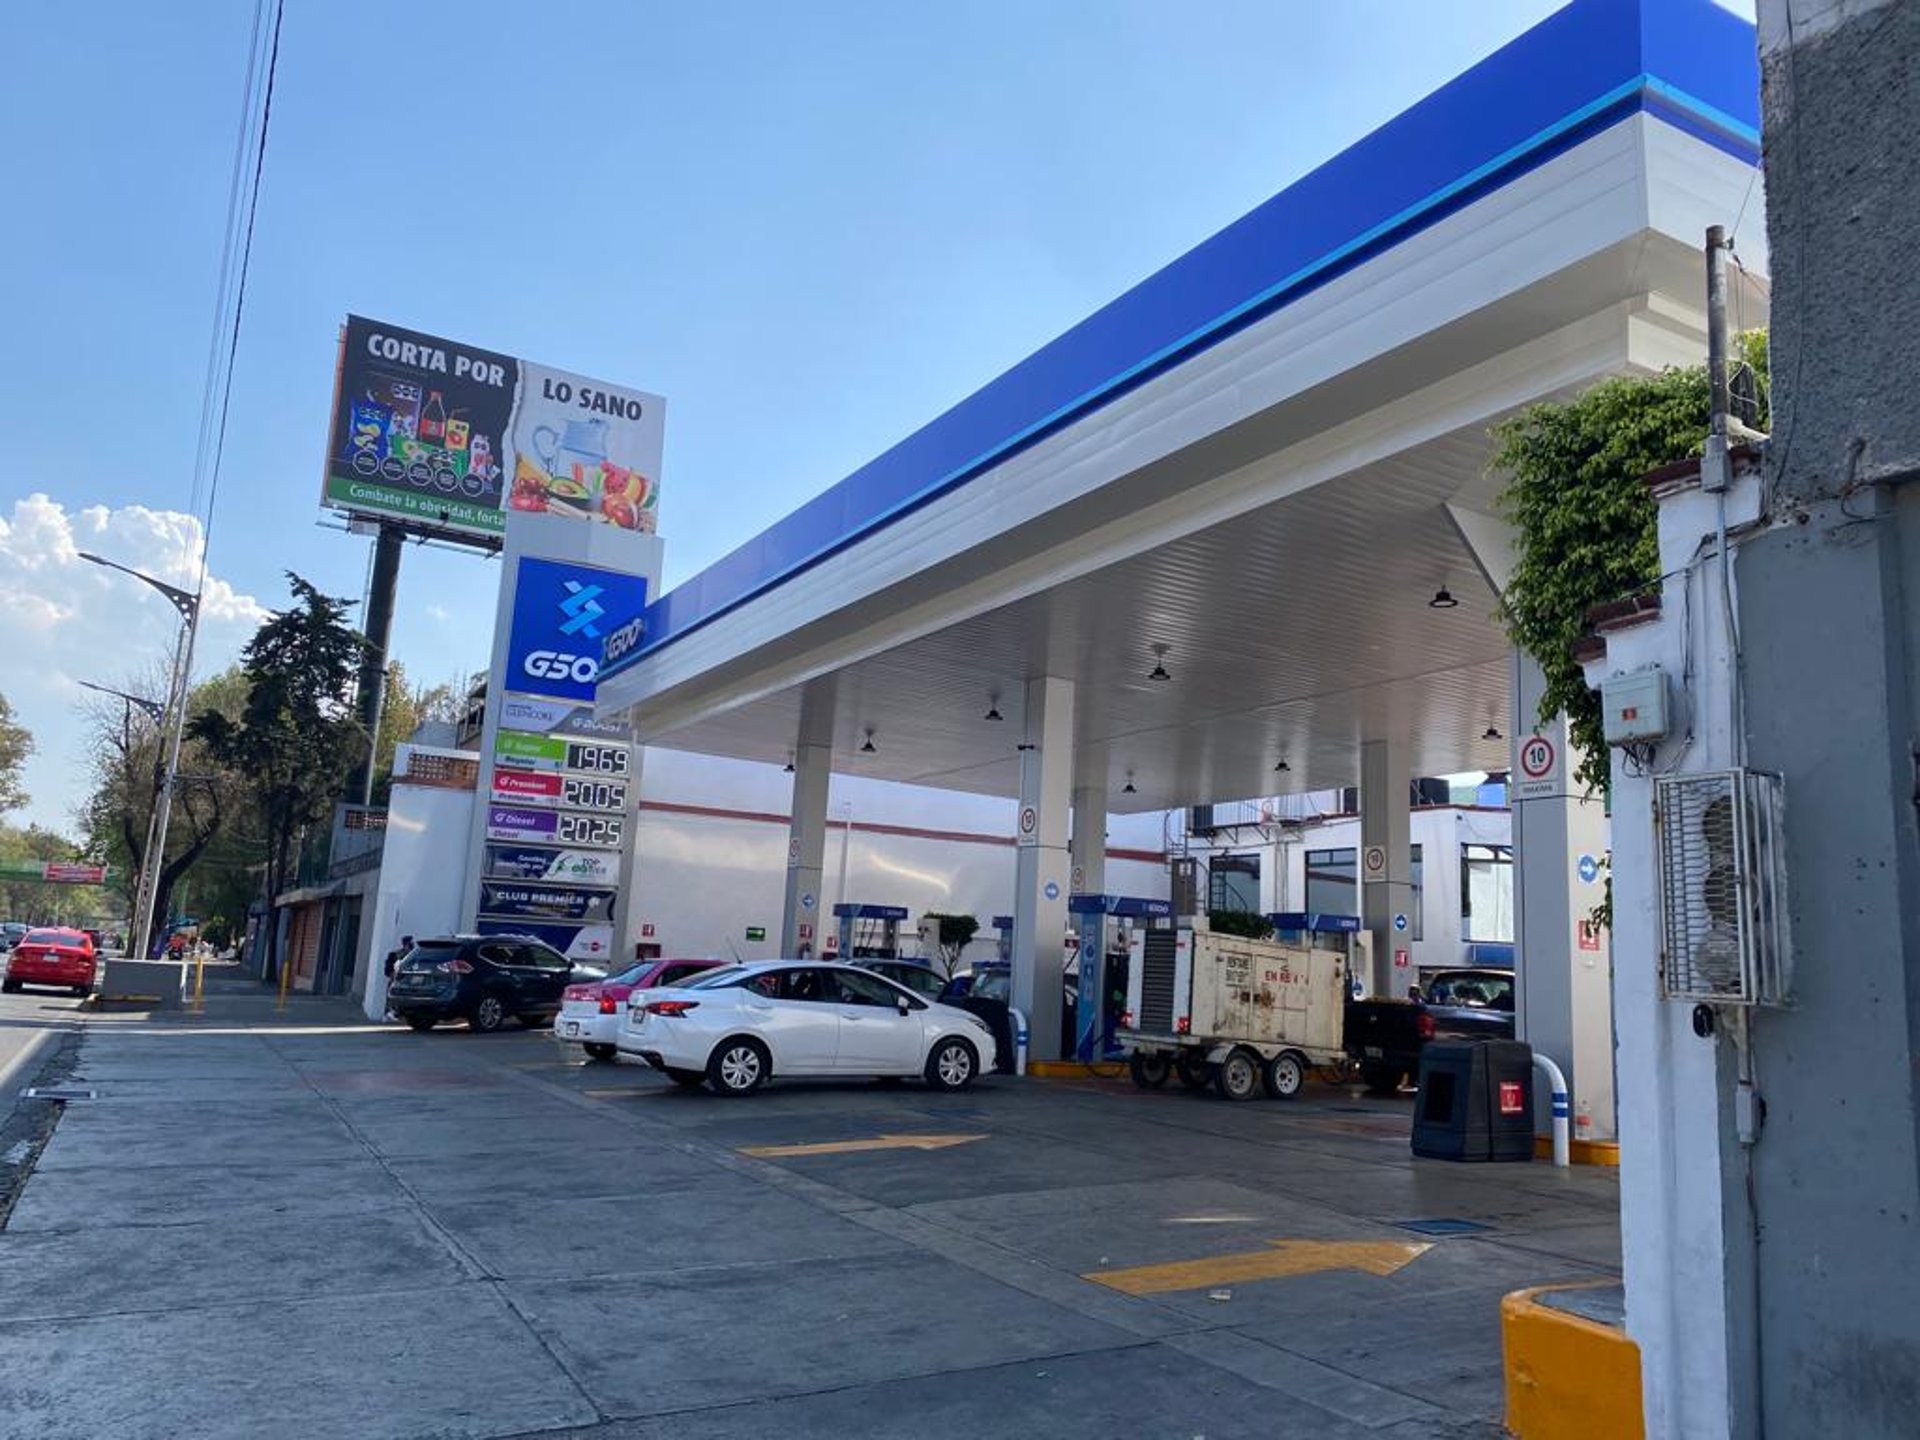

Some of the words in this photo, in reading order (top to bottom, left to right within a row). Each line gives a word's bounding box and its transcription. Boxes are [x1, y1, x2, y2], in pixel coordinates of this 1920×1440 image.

[367, 333, 447, 373] CORTA
[455, 356, 506, 388] POR
[543, 378, 572, 403] LO
[579, 387, 642, 421] SANO
[350, 484, 402, 507] Combate
[406, 495, 417, 507] la
[419, 499, 476, 521] obesidad,
[1529, 746, 1546, 765] 10
[496, 891, 529, 901] CLUB
[531, 893, 585, 904] PREMIER
[1265, 970, 1278, 981] EN
